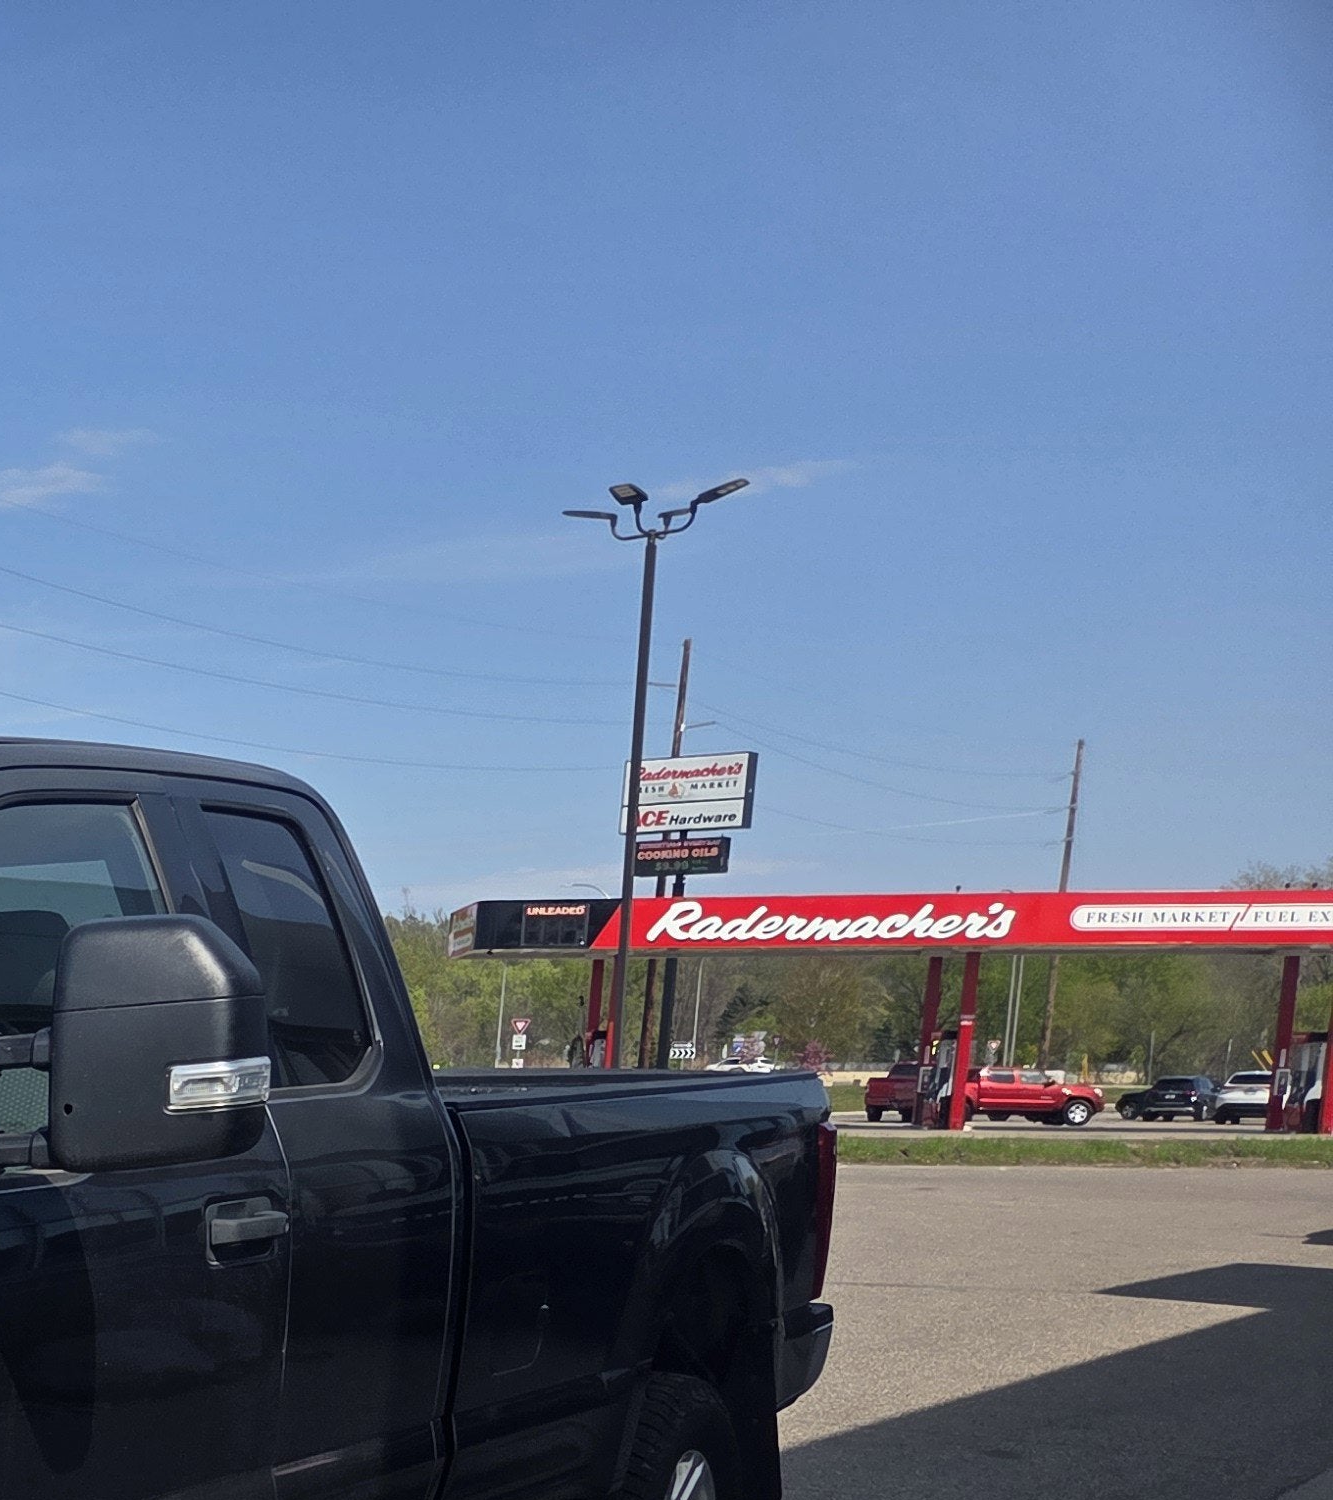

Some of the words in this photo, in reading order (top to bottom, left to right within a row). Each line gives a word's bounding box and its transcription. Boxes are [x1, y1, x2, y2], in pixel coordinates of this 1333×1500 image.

[690, 780, 738, 789] MARKET
[668, 813, 737, 825] Hardware
[637, 849, 689, 860] COOKING
[691, 847, 719, 857] OILS
[526, 905, 586, 916] UNLEADED
[1253, 910, 1300, 923] FUEL
[646, 901, 1016, 942] Radermacher's
[1086, 911, 1144, 923] FRESH
[1151, 911, 1231, 924] MARKET
